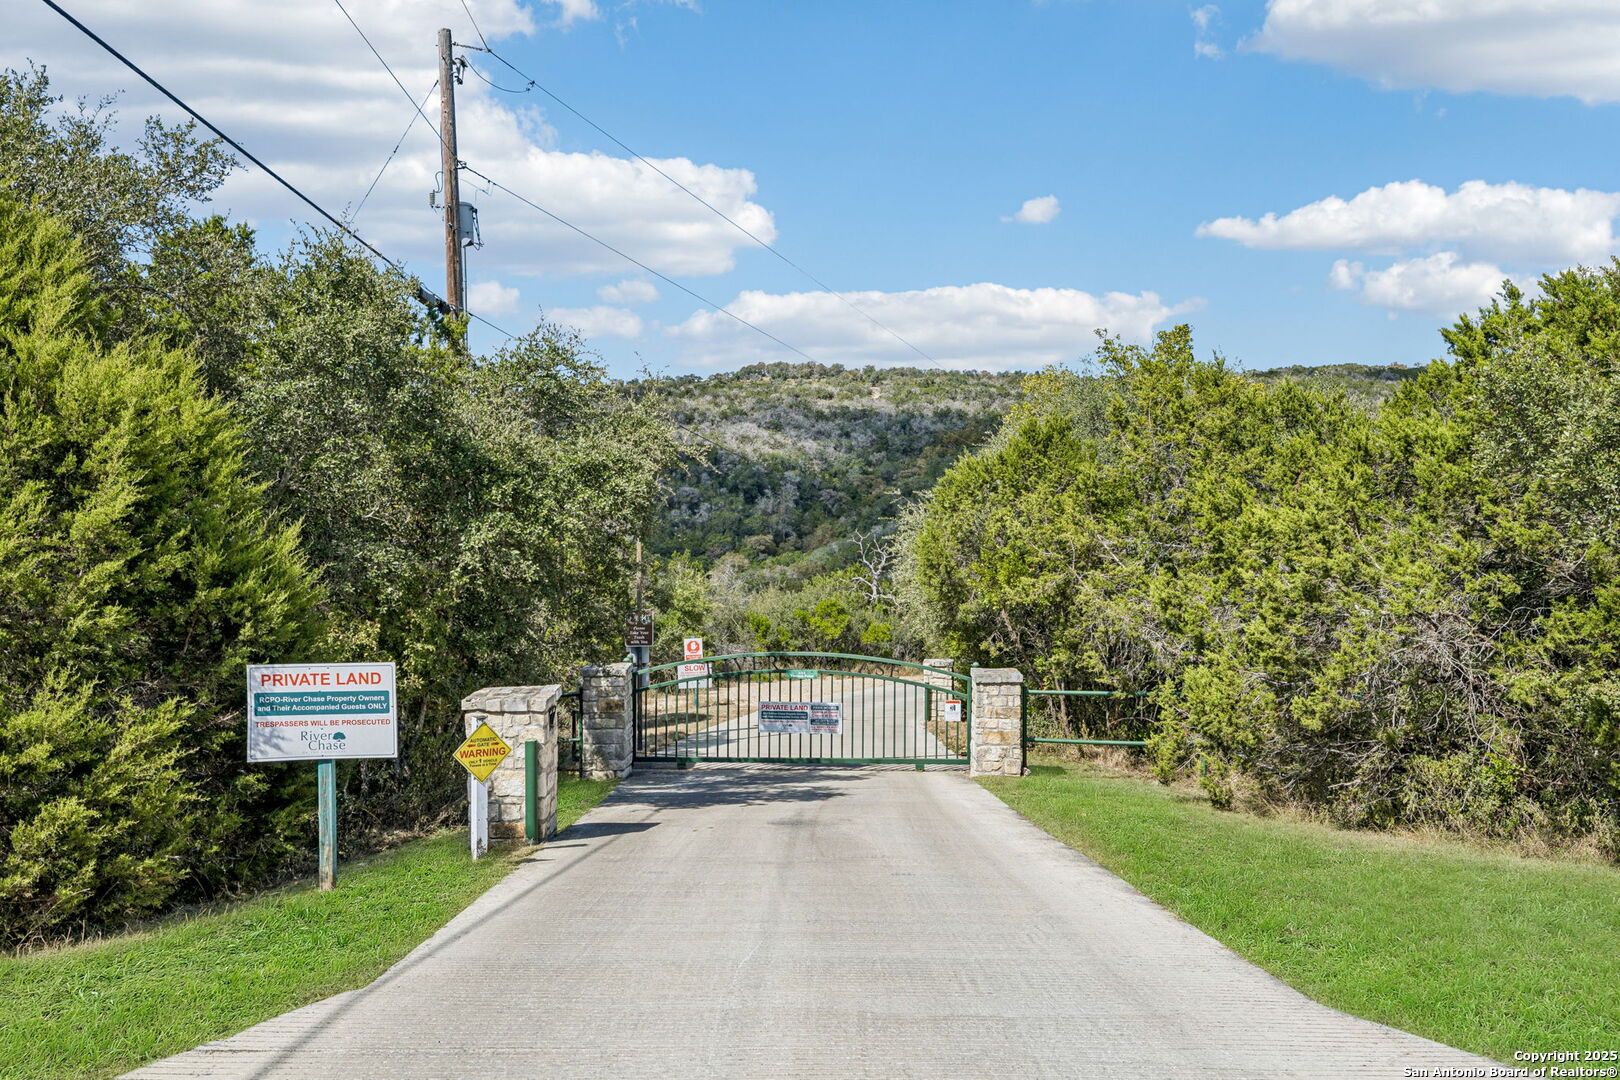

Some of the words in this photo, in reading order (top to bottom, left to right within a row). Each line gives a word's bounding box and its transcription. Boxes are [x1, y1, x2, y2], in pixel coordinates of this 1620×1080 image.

[261, 672, 330, 686] PRIVATE
[336, 672, 382, 685] LAND
[292, 704, 340, 712] Accompanied
[300, 731, 332, 740] River
[308, 740, 346, 750] Chase
[460, 747, 506, 758] WARNING
